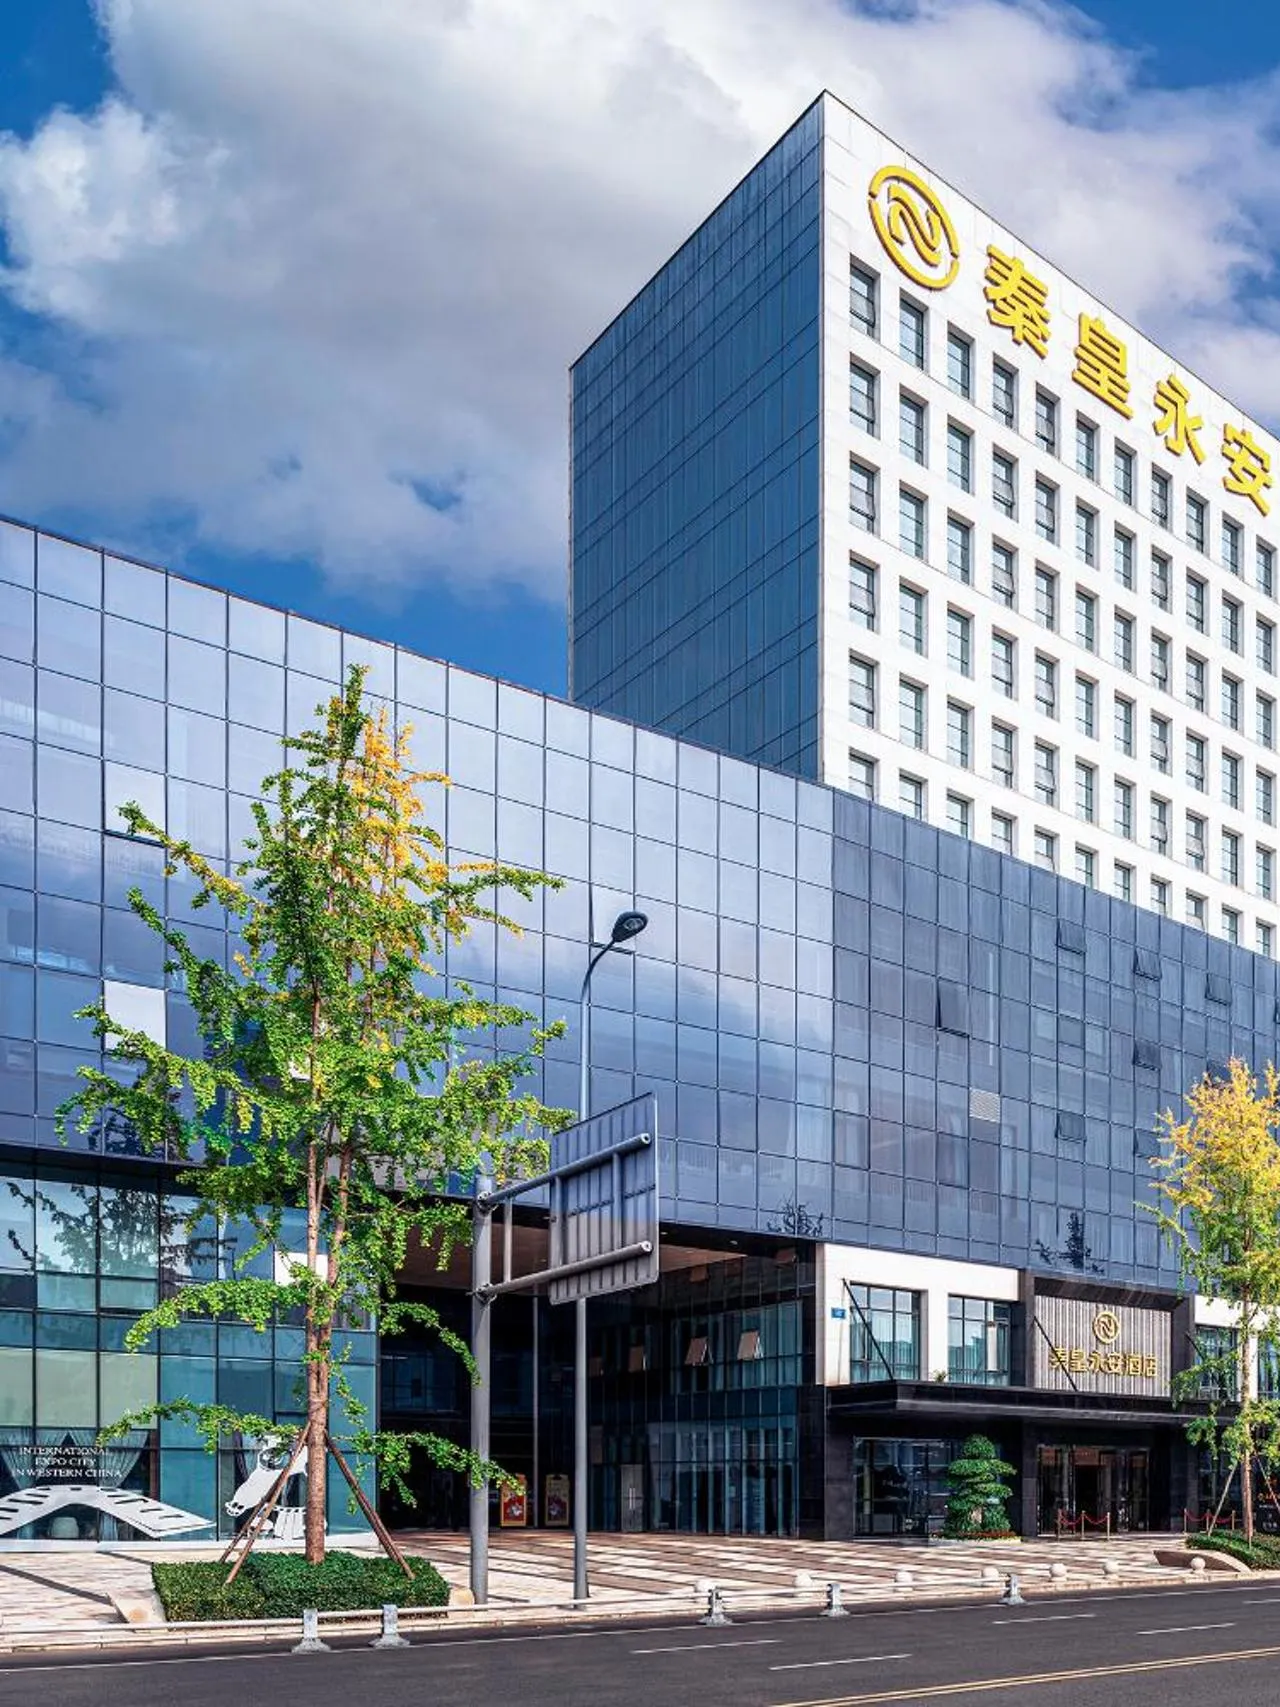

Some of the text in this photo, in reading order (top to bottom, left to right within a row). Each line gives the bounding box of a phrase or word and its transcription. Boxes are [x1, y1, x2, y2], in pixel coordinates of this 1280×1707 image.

[1049, 1346, 1158, 1377] 秦皇永安酒店
[20, 1447, 110, 1456] INTERNATIONAL
[35, 1457, 97, 1467] EXPO CITY
[26, 1468, 83, 1478] WESTERN
[84, 1469, 122, 1478] CHINA
